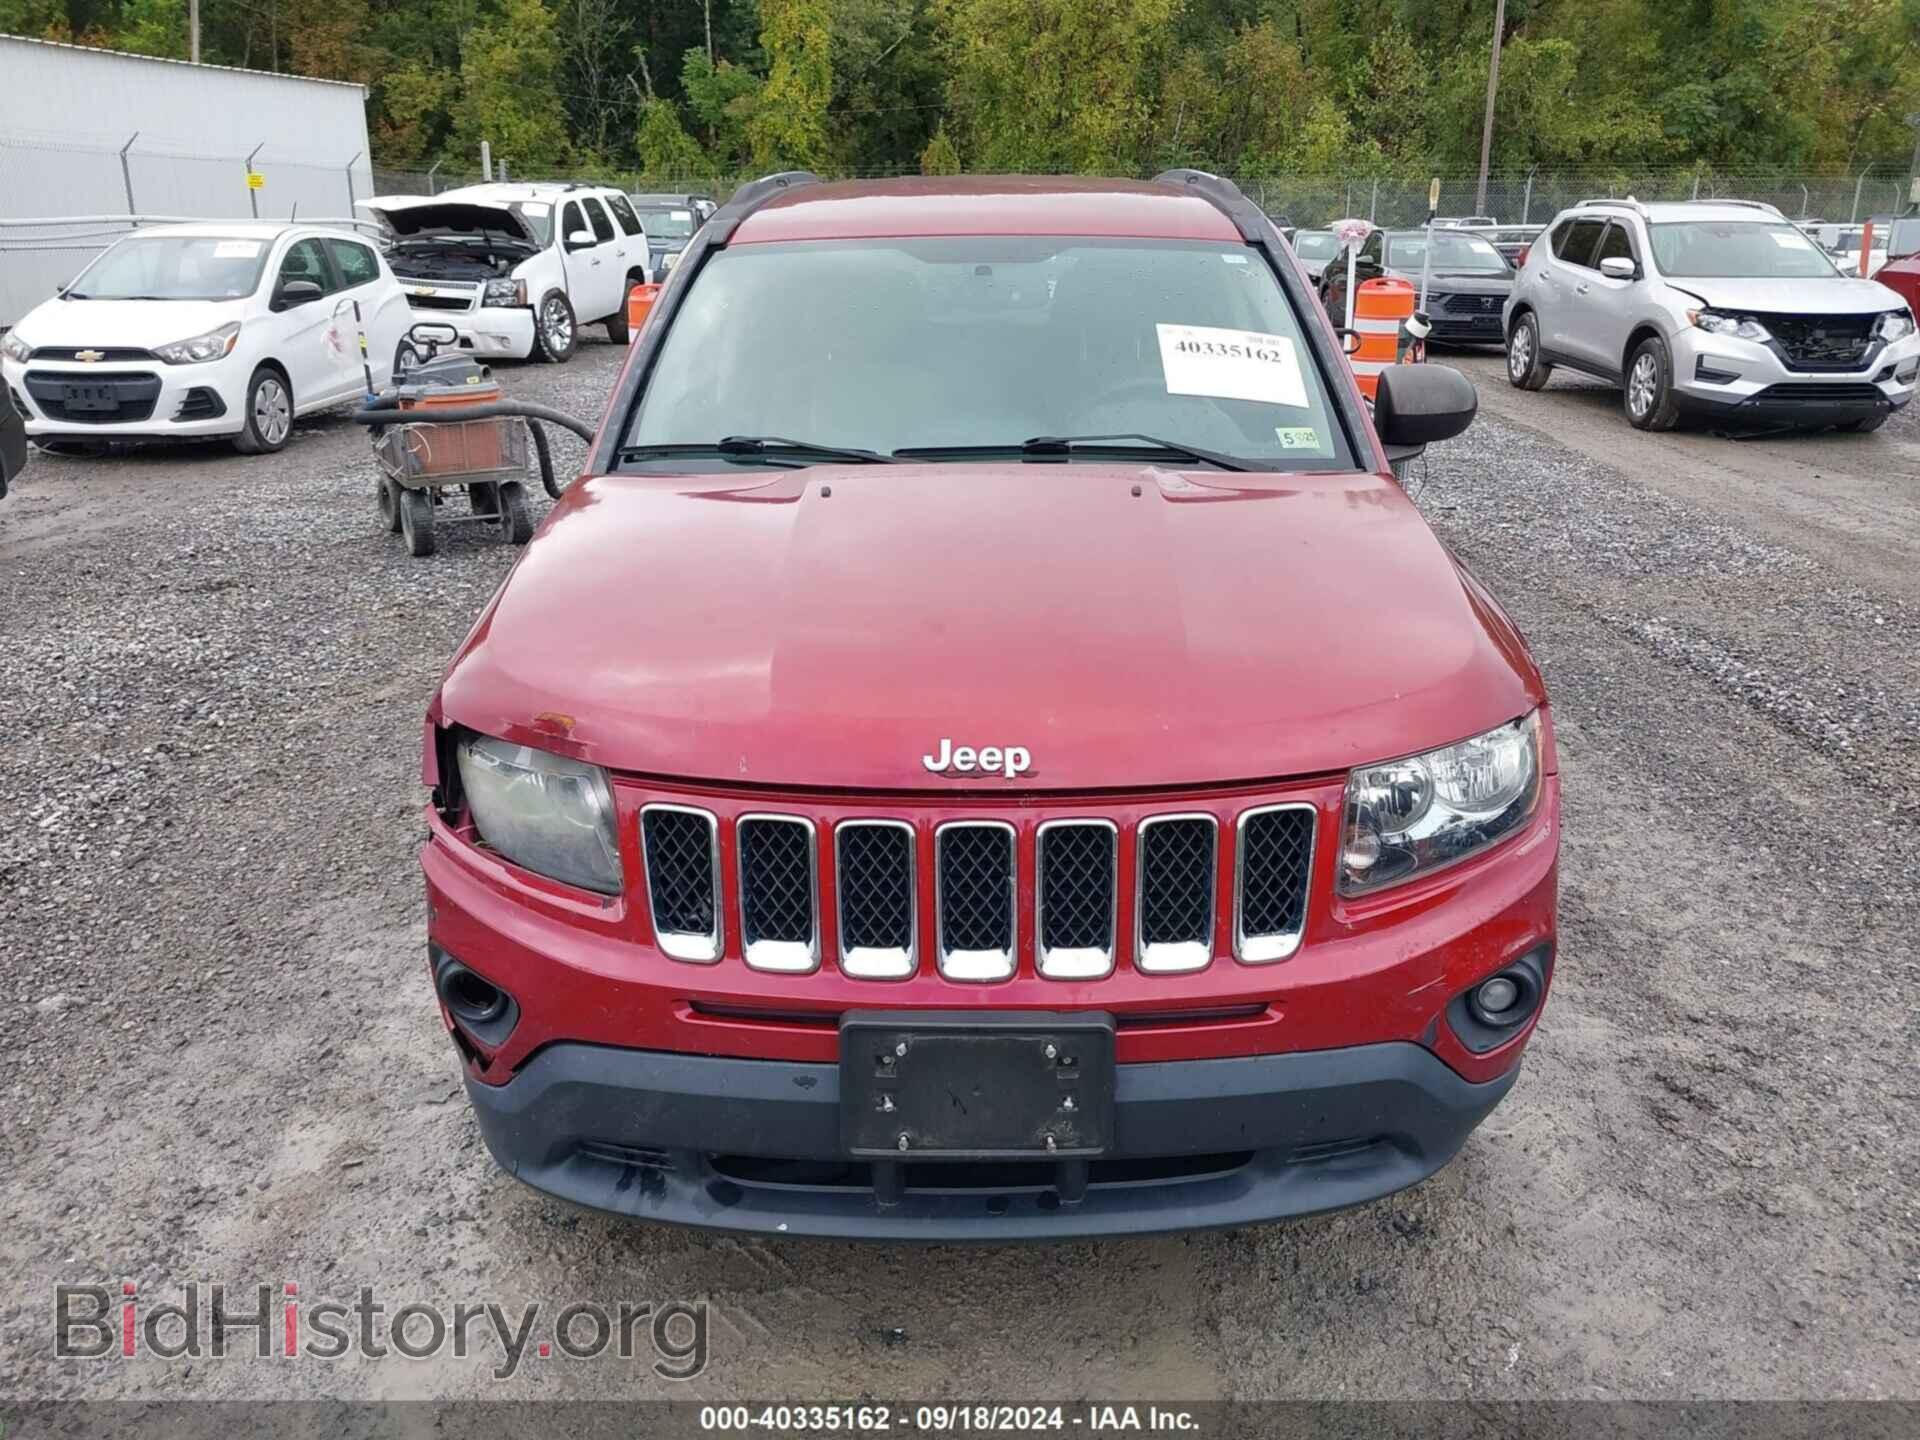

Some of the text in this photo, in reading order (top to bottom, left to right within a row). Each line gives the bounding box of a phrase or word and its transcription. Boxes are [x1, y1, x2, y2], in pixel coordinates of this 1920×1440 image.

[1174, 340, 1282, 363] 40335162
[1283, 432, 1295, 445] 5
[922, 738, 1031, 778] Jeep
